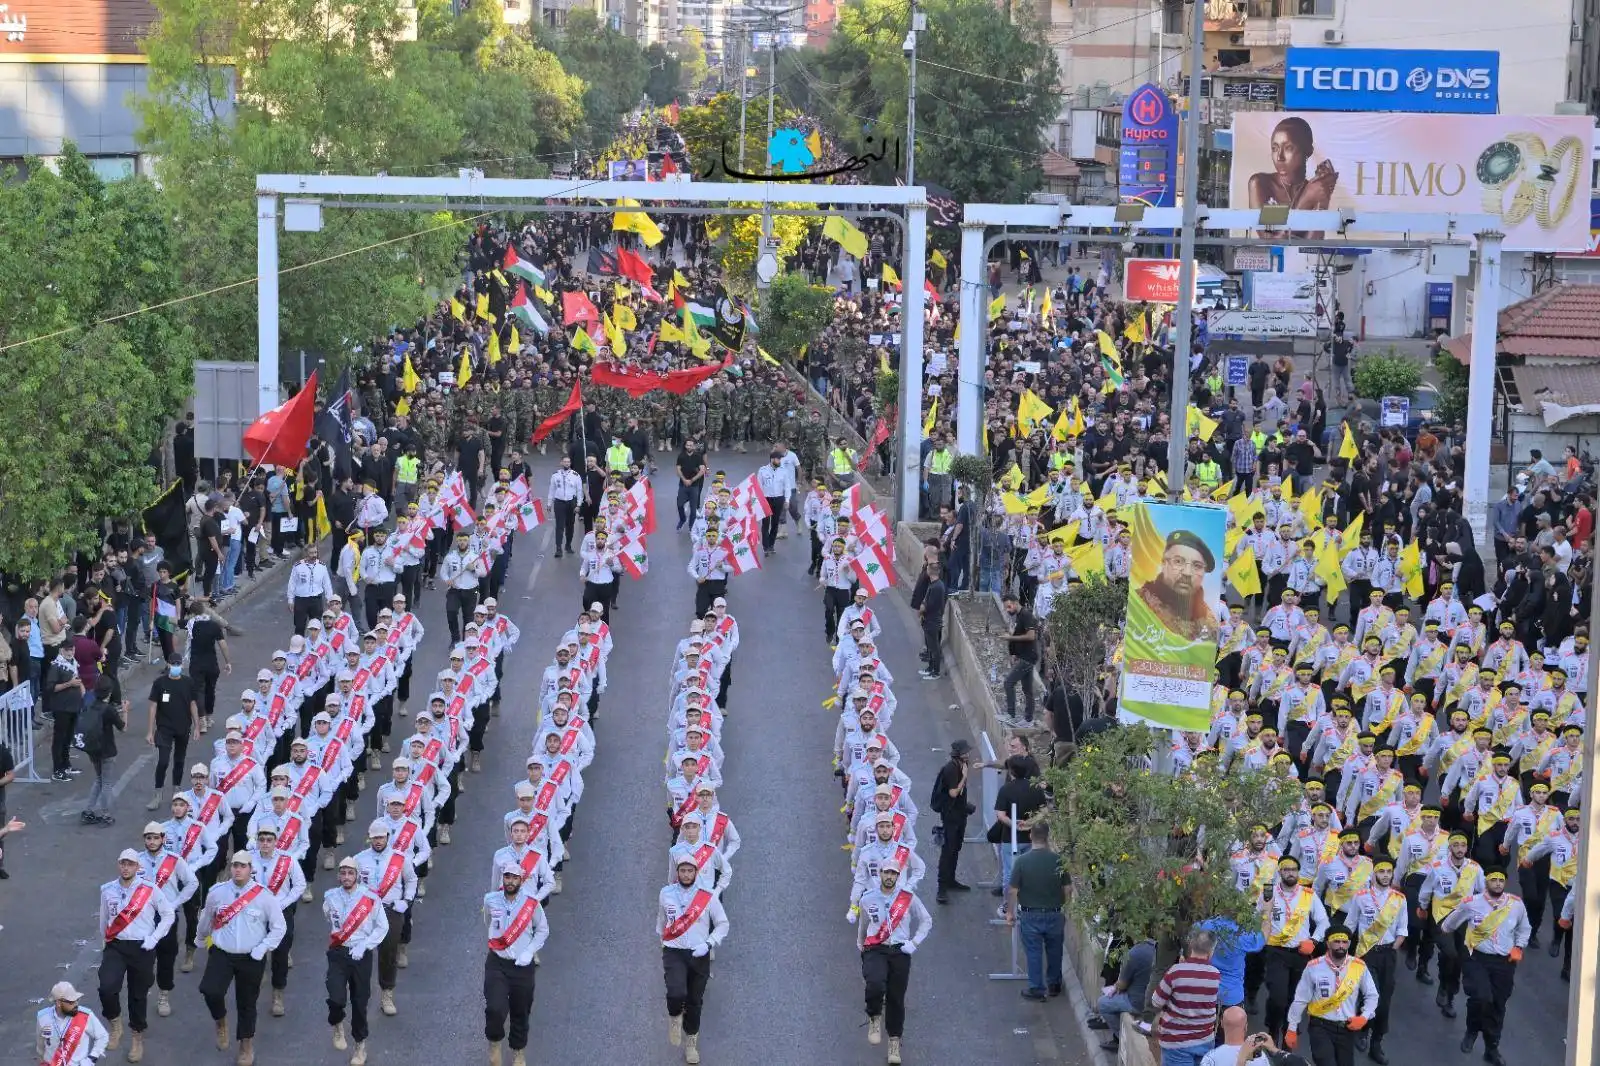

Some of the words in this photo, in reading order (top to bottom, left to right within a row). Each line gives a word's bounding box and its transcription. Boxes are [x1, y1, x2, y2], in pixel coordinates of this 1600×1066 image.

[1290, 66, 1399, 92] TECNO
[1436, 67, 1491, 89] DNS
[1435, 91, 1491, 100] MOBILES
[1125, 127, 1168, 141] Hypco
[1354, 161, 1466, 197] HIMO
[1147, 282, 1180, 293] whish
